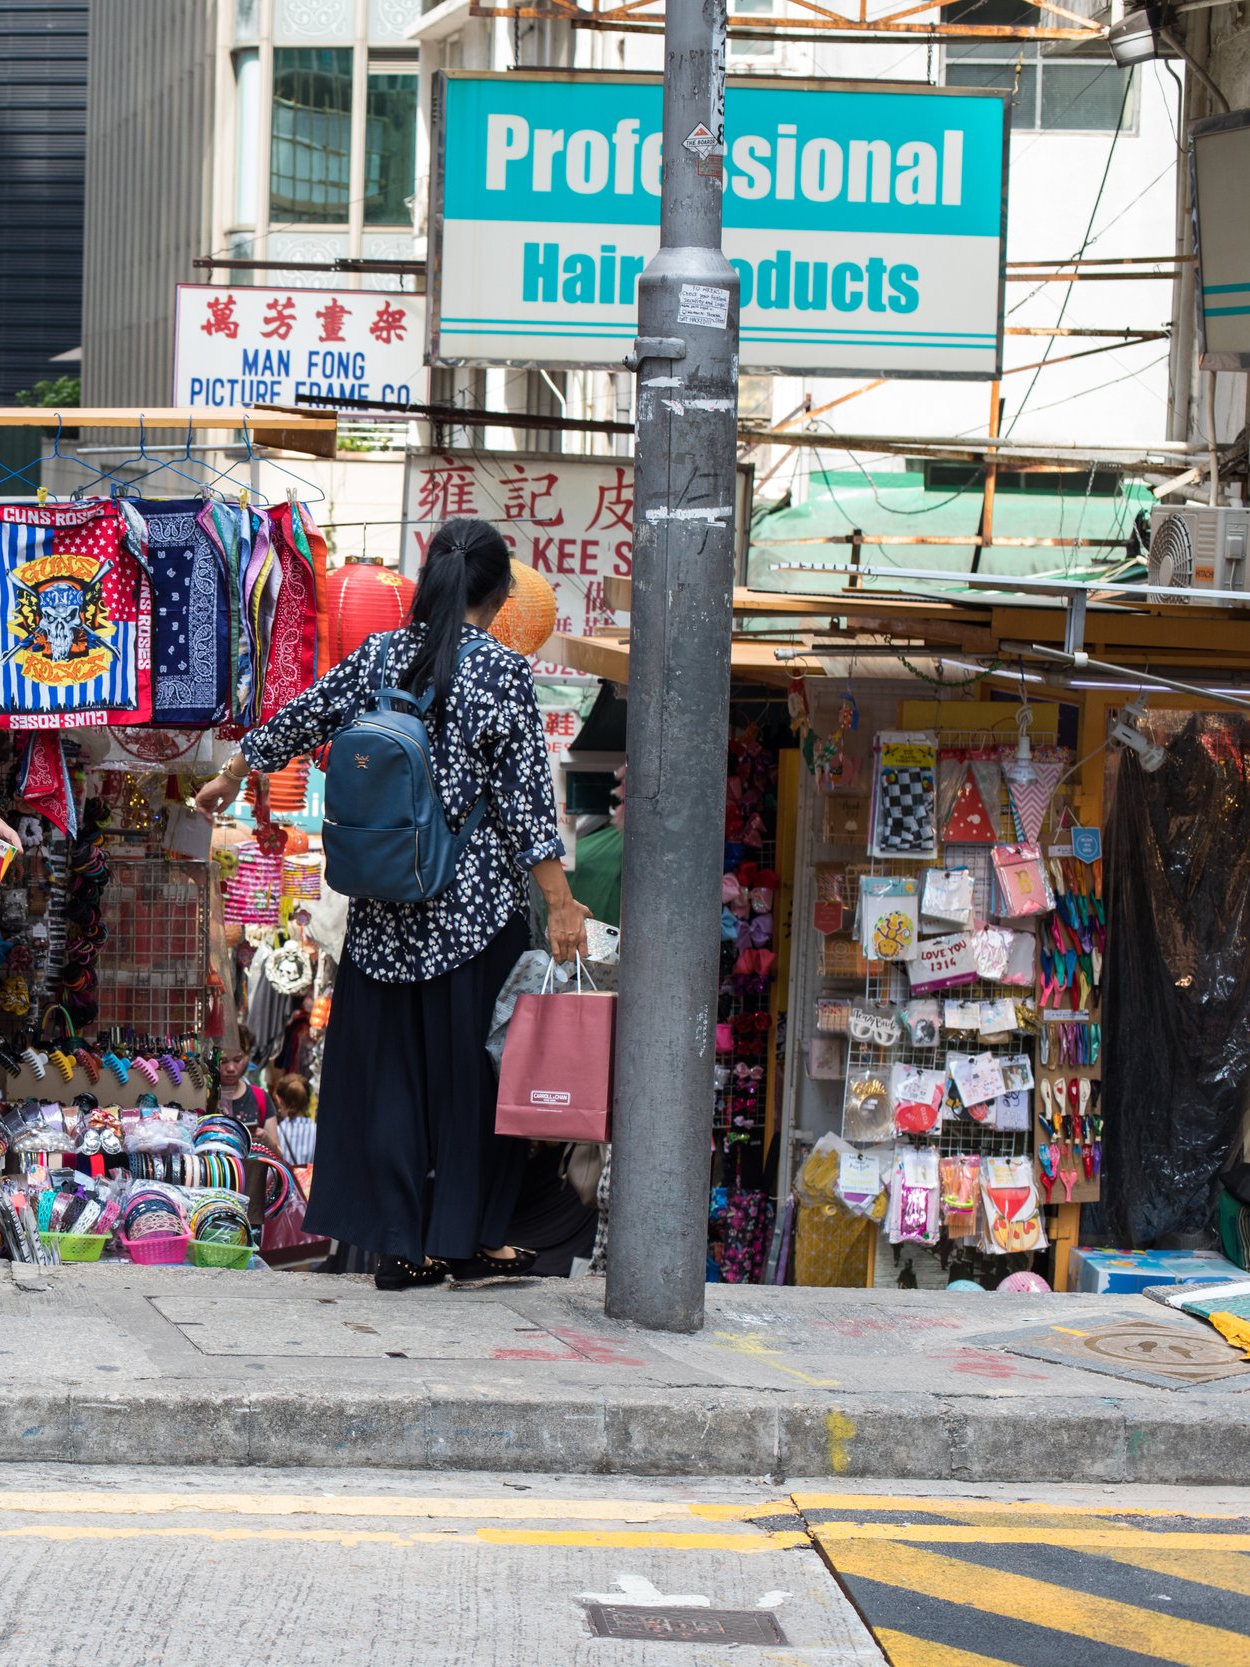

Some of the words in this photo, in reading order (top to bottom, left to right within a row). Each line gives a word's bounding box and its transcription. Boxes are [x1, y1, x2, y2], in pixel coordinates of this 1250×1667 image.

[486, 113, 964, 206] Profesional
[523, 242, 642, 305] Hair
[732, 249, 920, 314] oducts
[201, 294, 408, 345] 萬芳畫架
[242, 348, 291, 378] MAN
[308, 350, 366, 380] FONG
[20, 555, 100, 583] GUNS
[532, 537, 600, 576] KEE
[920, 945, 946, 961] LOVE
[948, 939, 967, 954] YOU
